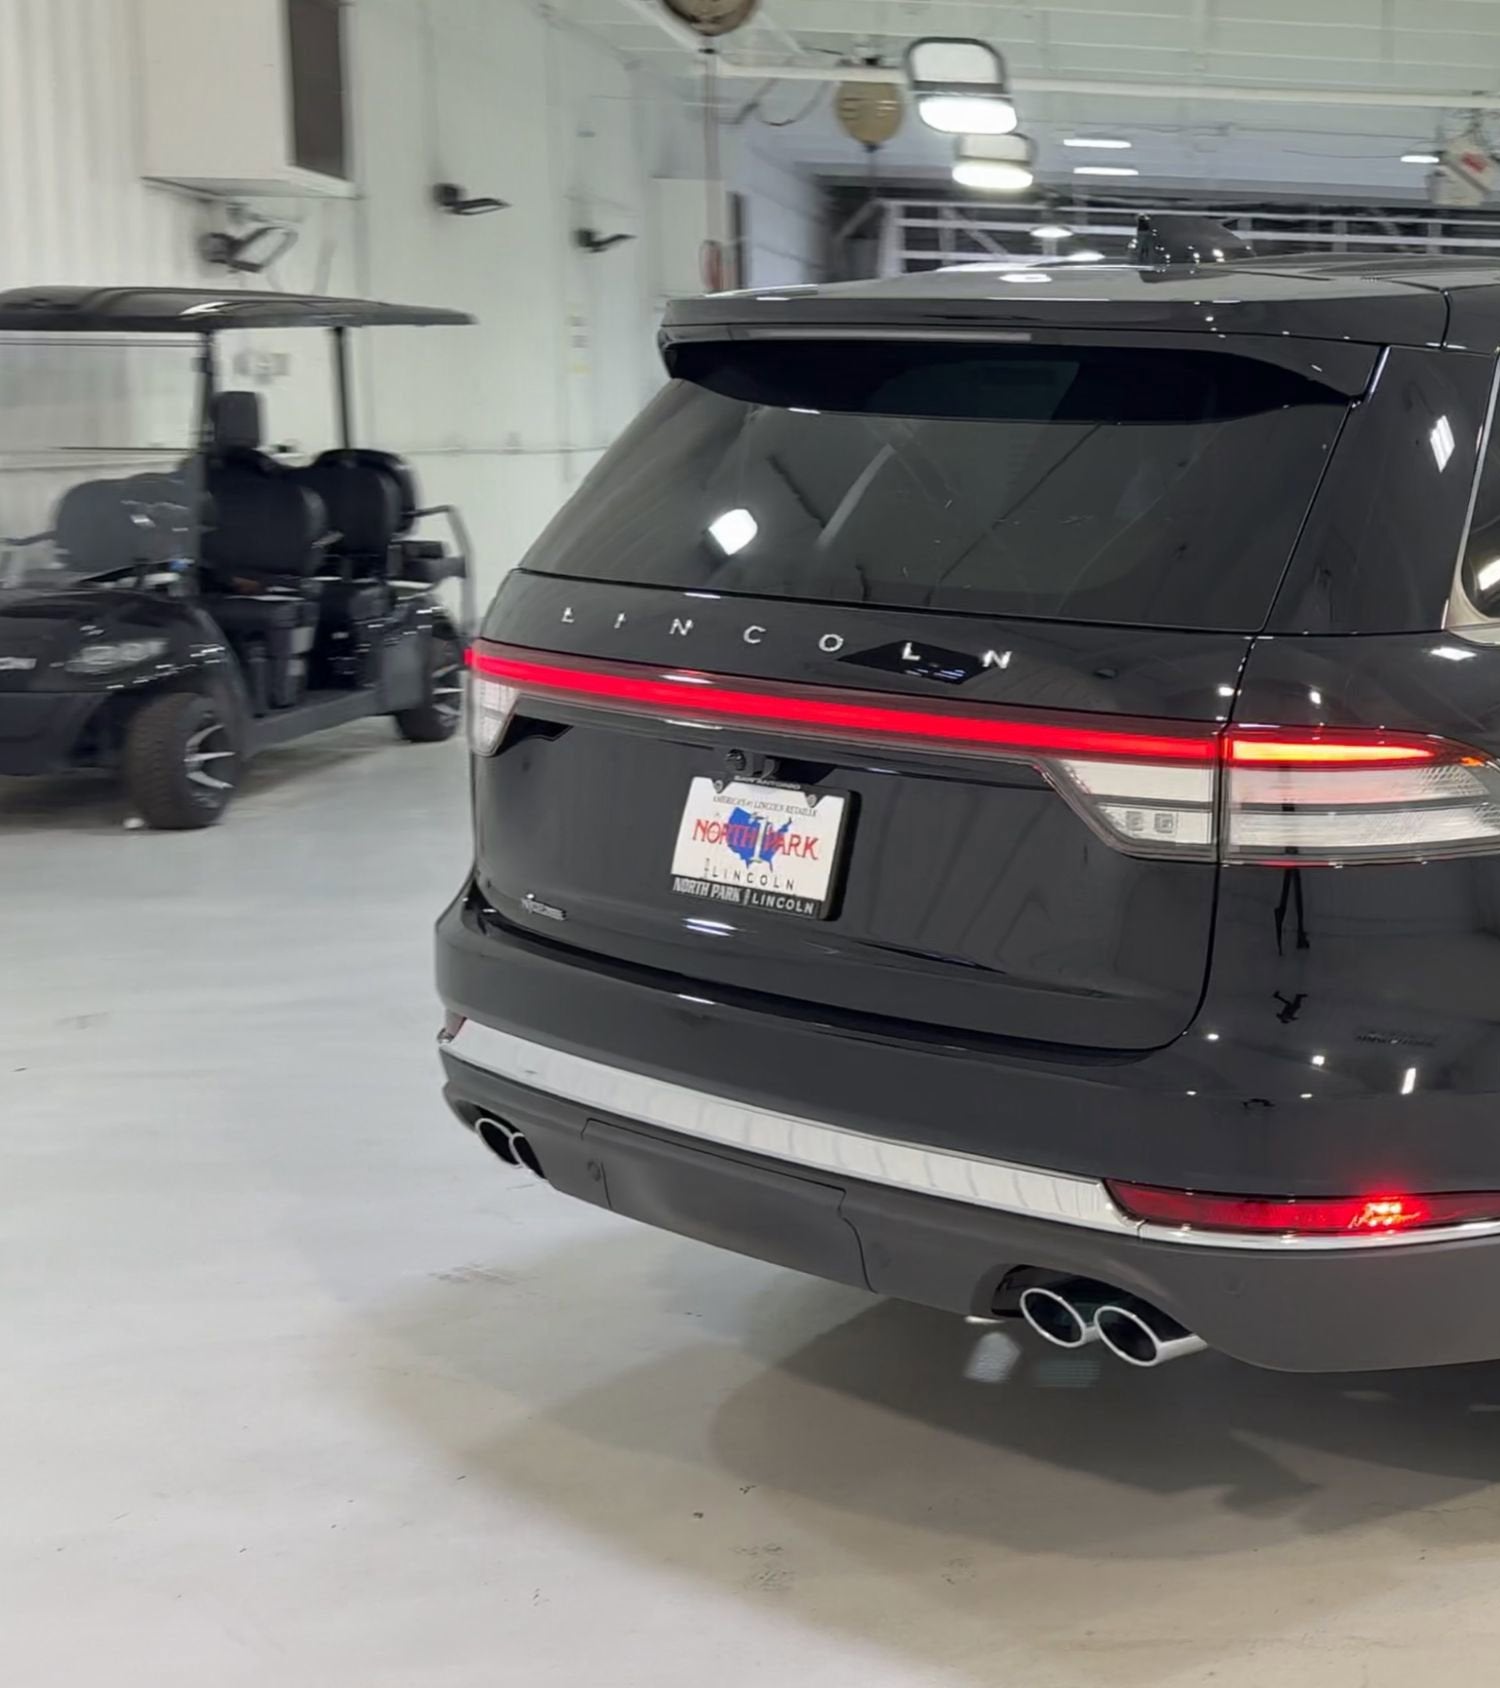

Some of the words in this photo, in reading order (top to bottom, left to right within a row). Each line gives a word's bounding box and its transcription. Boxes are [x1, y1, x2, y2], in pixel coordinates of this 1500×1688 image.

[561, 607, 1013, 668] LINCOLN
[692, 819, 757, 849] NORTH
[765, 827, 819, 860] PARK
[673, 877, 708, 897] NORTH
[711, 884, 741, 903] PARK
[752, 892, 814, 914] LINCOLN
[713, 866, 795, 891] LINCOLN
